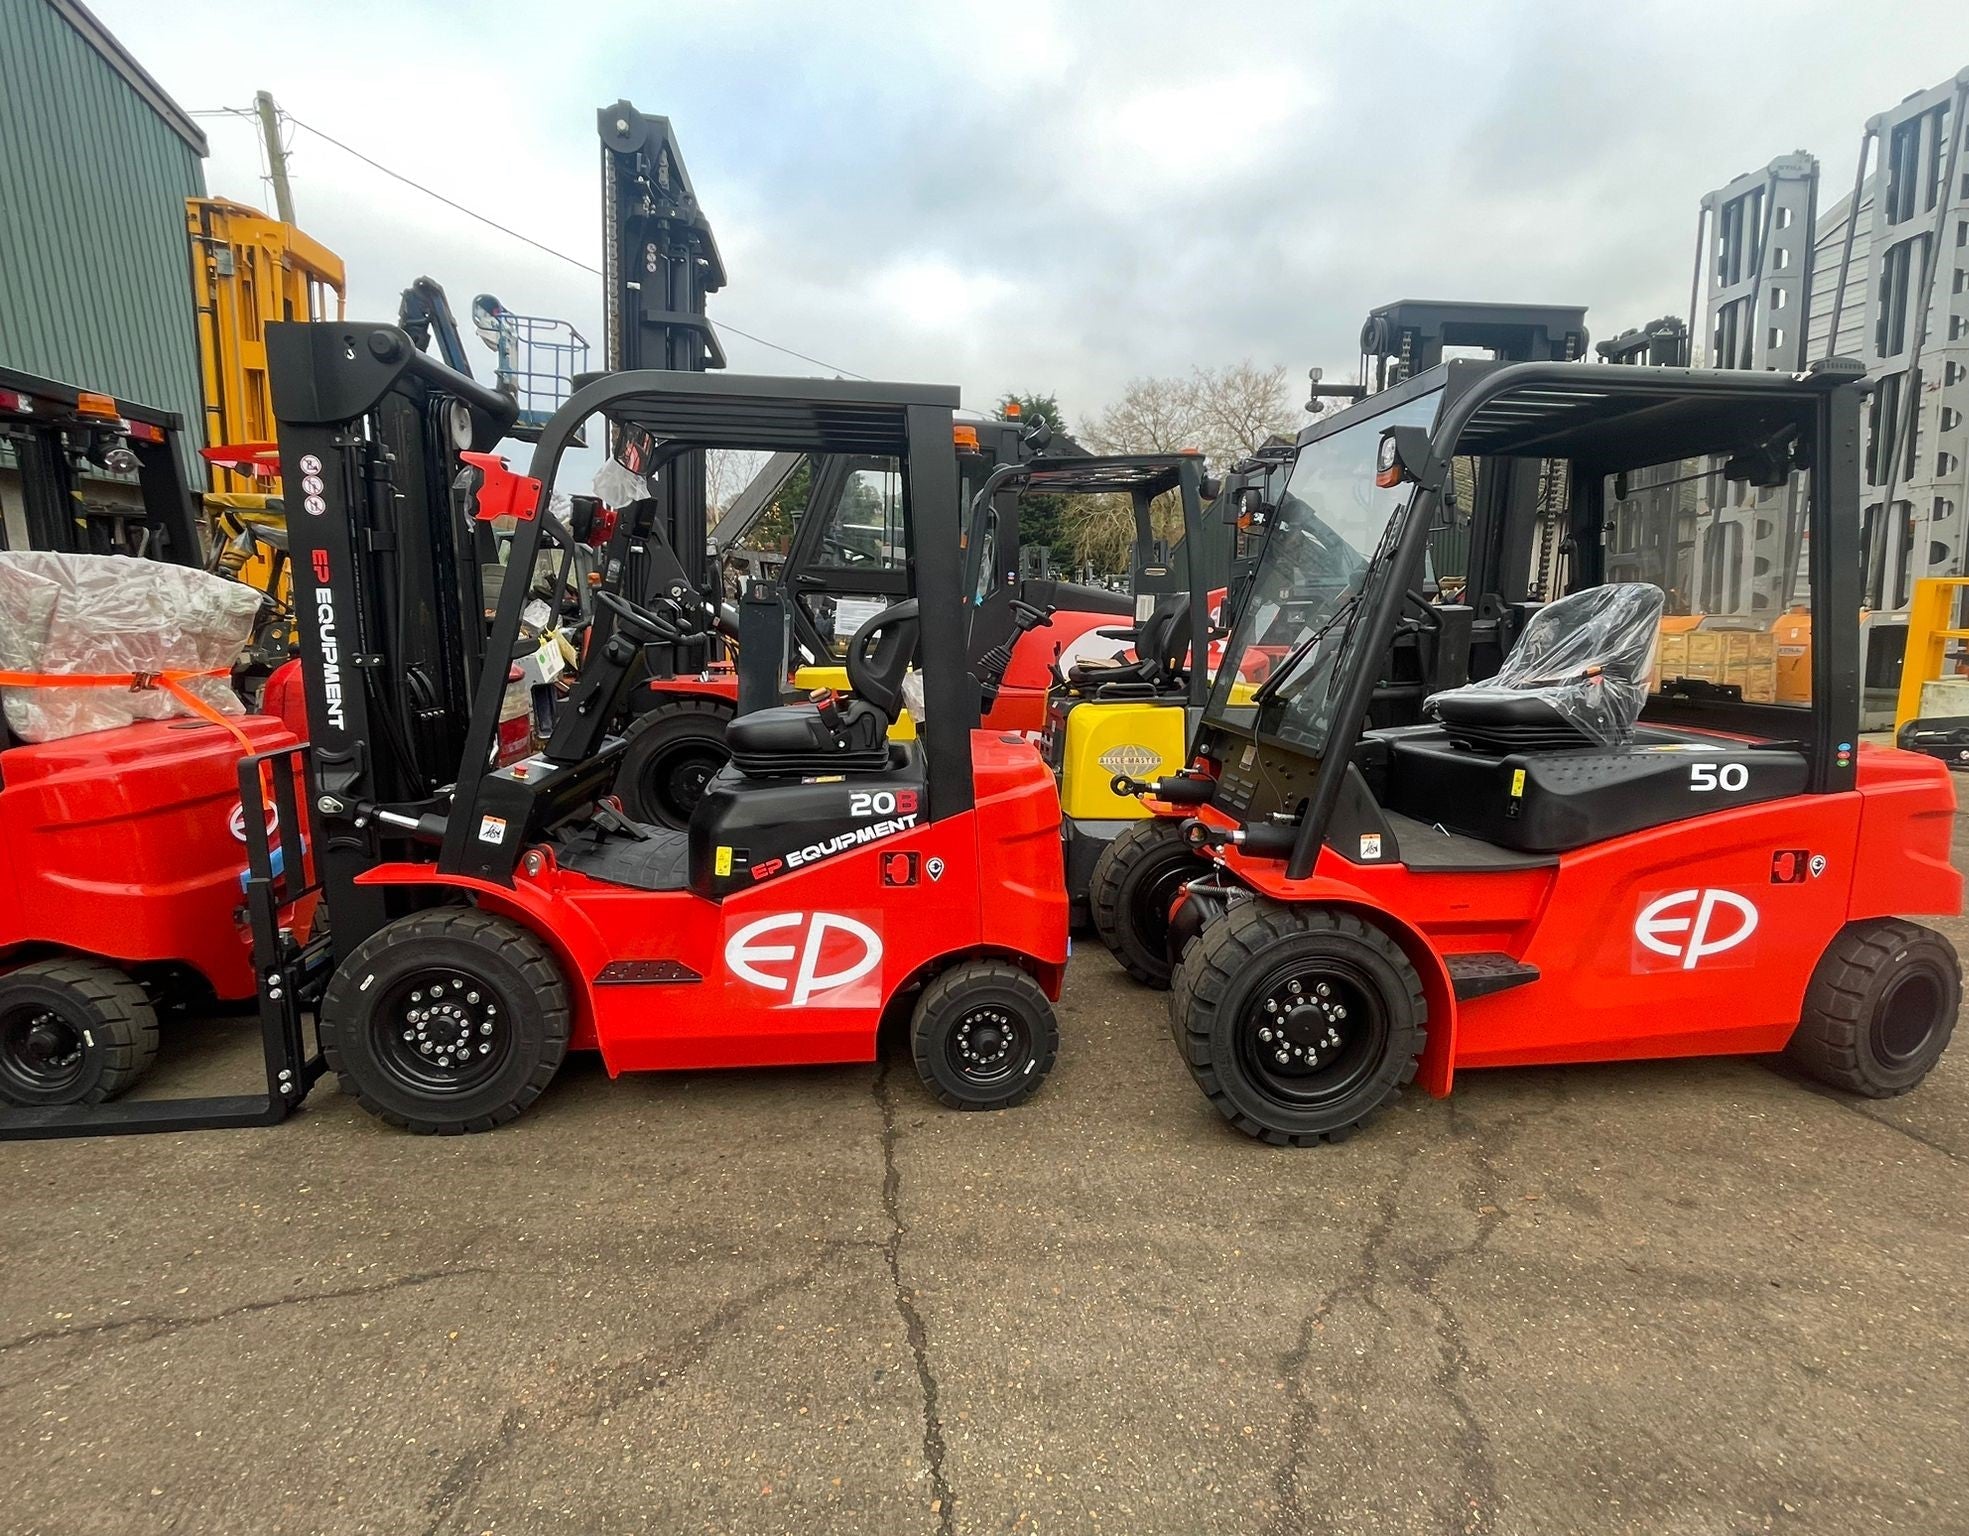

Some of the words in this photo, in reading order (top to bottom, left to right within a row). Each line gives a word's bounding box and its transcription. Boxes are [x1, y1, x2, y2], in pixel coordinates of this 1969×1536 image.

[312, 549, 331, 584] EP
[315, 587, 345, 731] EQUIPMENT
[850, 789, 919, 816] 20B
[1690, 763, 1749, 792] 50
[751, 858, 783, 880] EP
[785, 813, 918, 869] EQUIPMENT
[724, 912, 883, 1006] EP
[1634, 888, 1759, 970] EP
